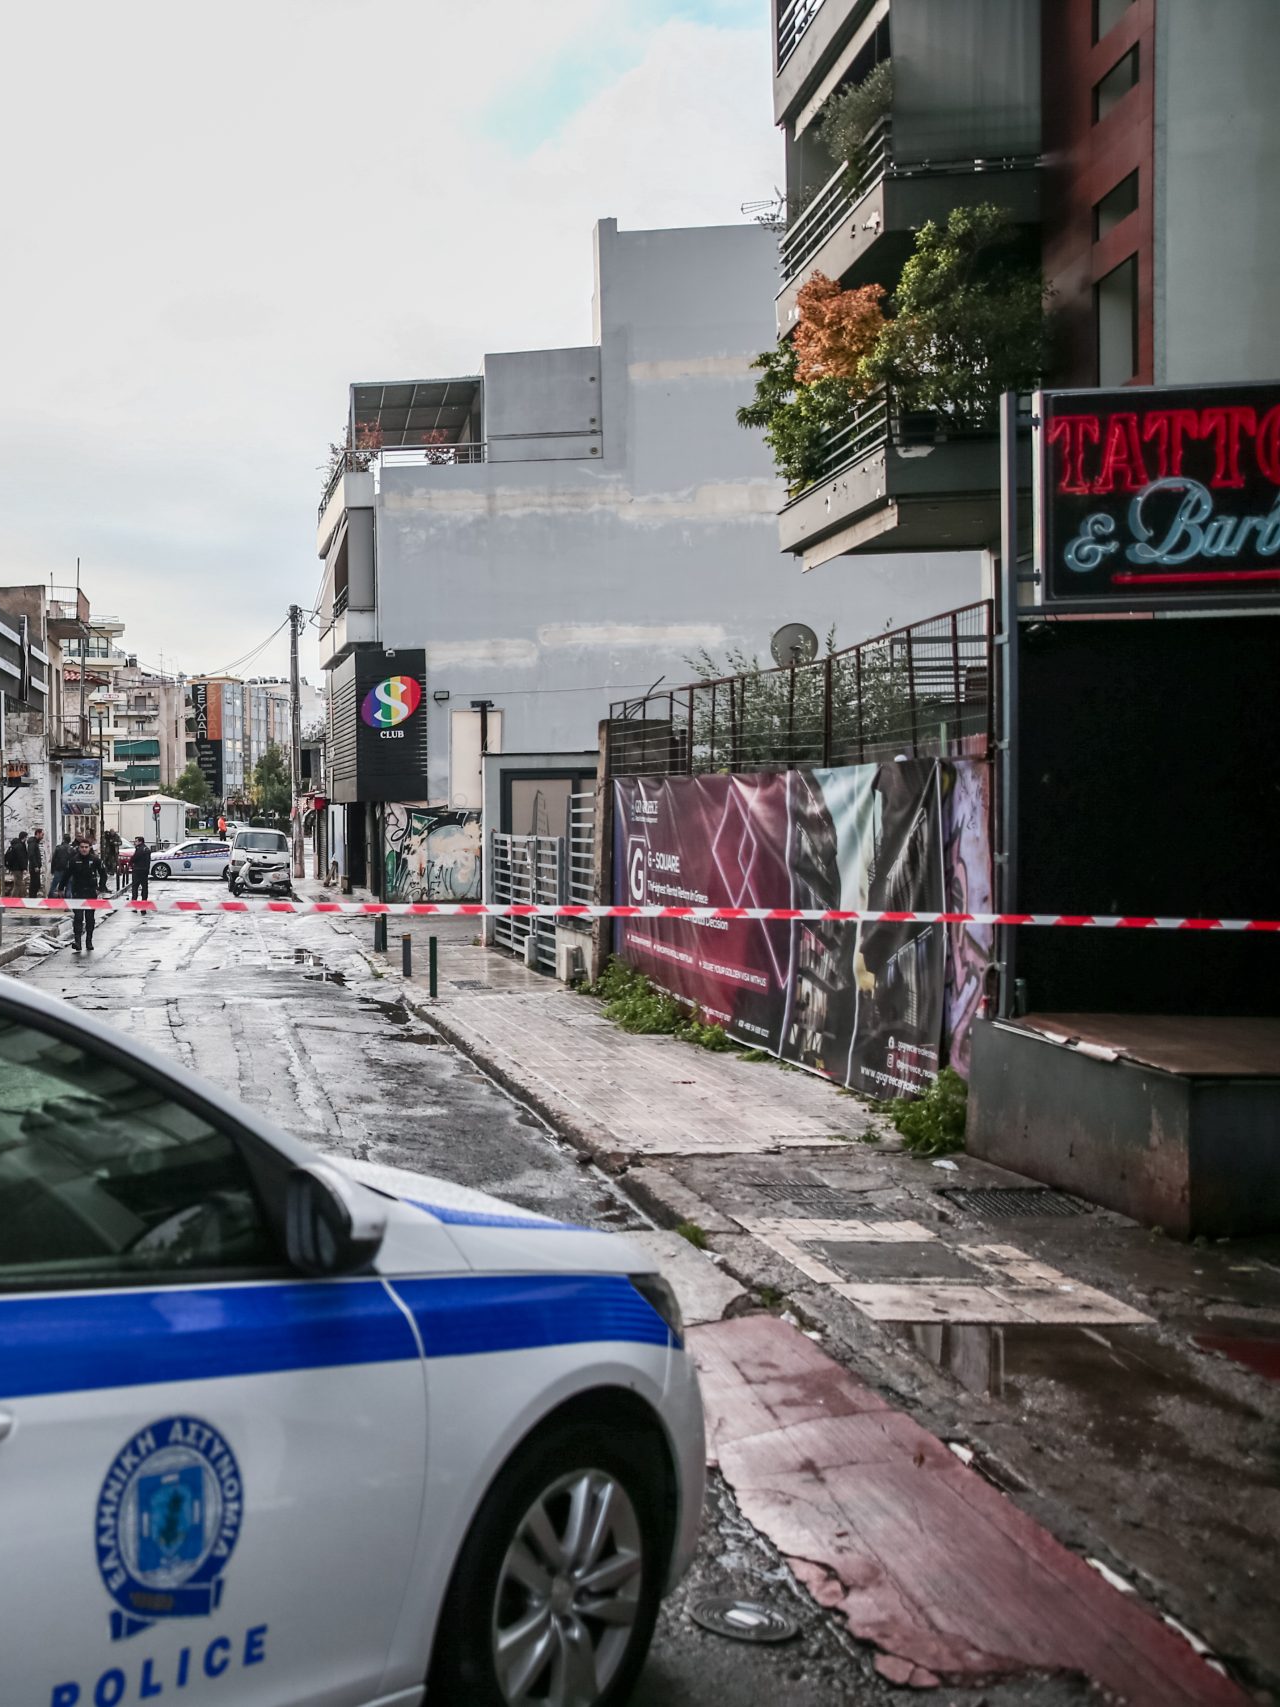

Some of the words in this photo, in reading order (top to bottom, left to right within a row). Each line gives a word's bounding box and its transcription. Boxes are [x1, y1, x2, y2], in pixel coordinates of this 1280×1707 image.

[1063, 512, 1120, 573] &
[380, 730, 404, 738] CLUB
[50, 1623, 269, 1707] POLICE
